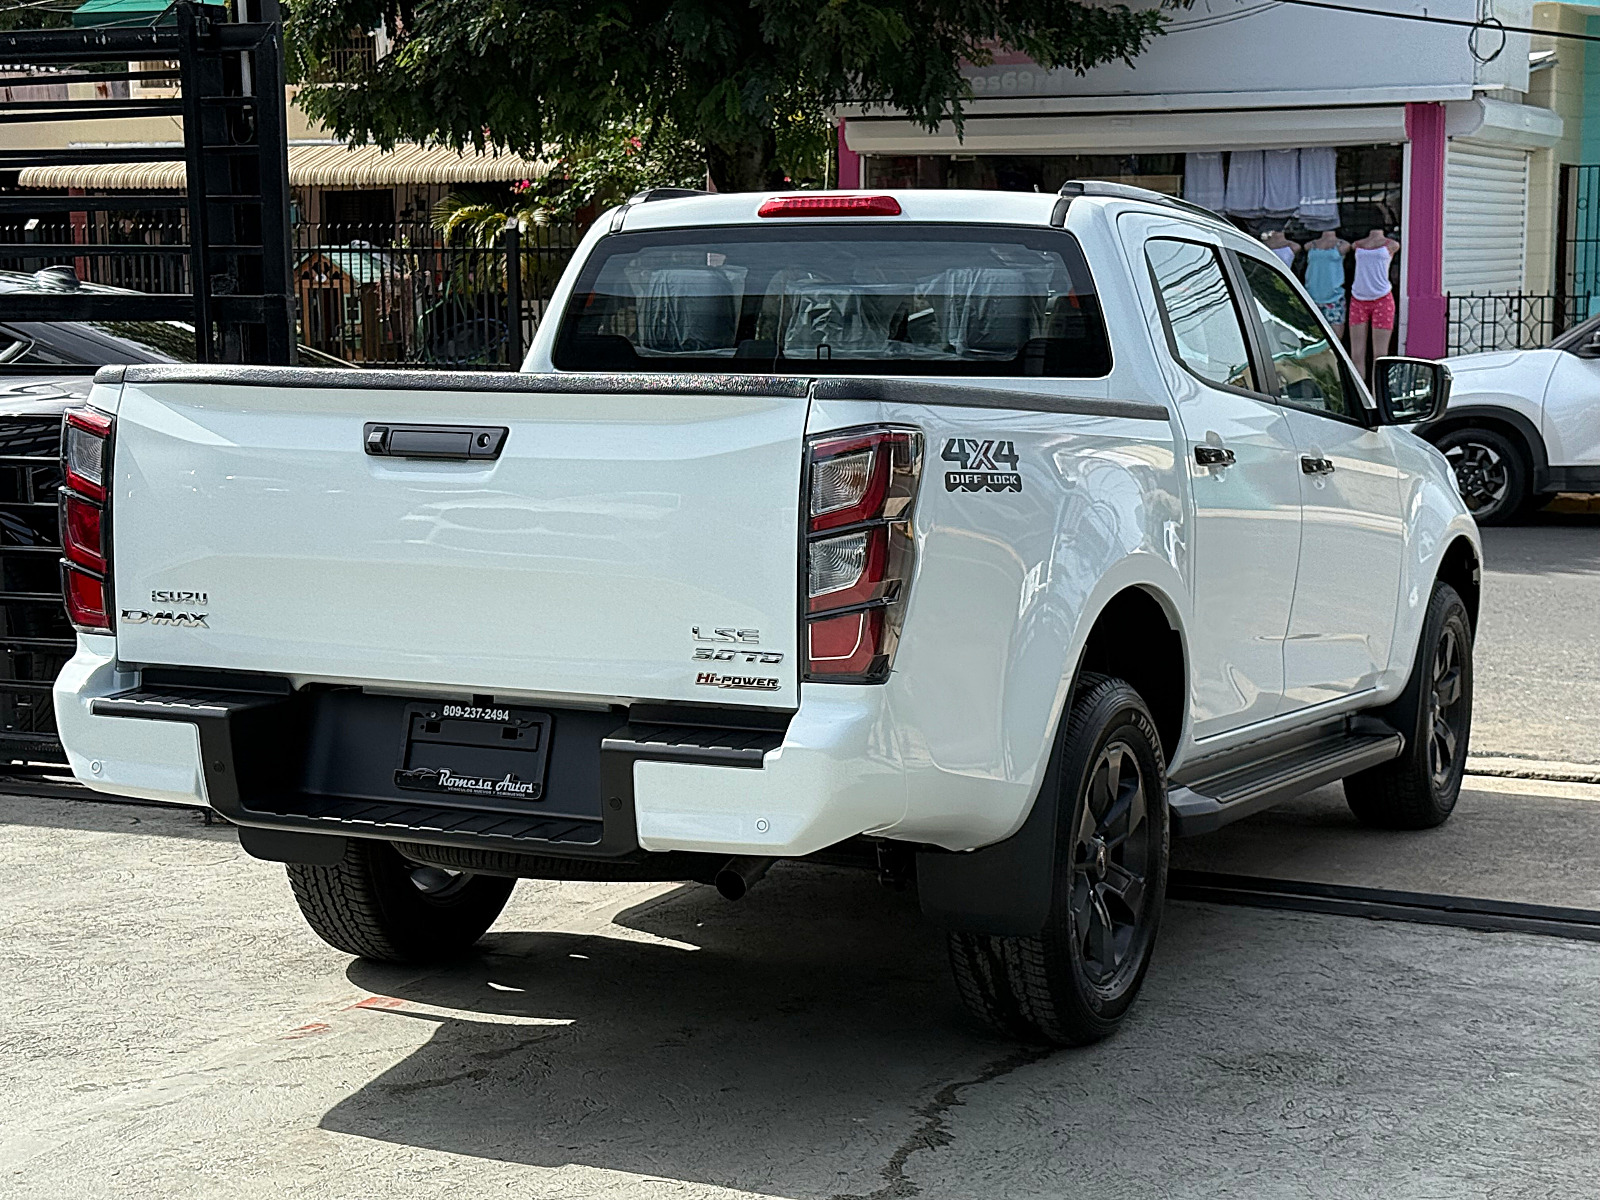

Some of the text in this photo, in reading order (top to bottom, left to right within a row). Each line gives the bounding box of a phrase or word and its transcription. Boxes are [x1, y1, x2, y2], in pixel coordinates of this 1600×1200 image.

[950, 474, 1018, 485] DIFF LOCK
[692, 627, 759, 644] LSE
[443, 705, 509, 721] 809-237-2494
[438, 769, 535, 793] Romesa Autos
